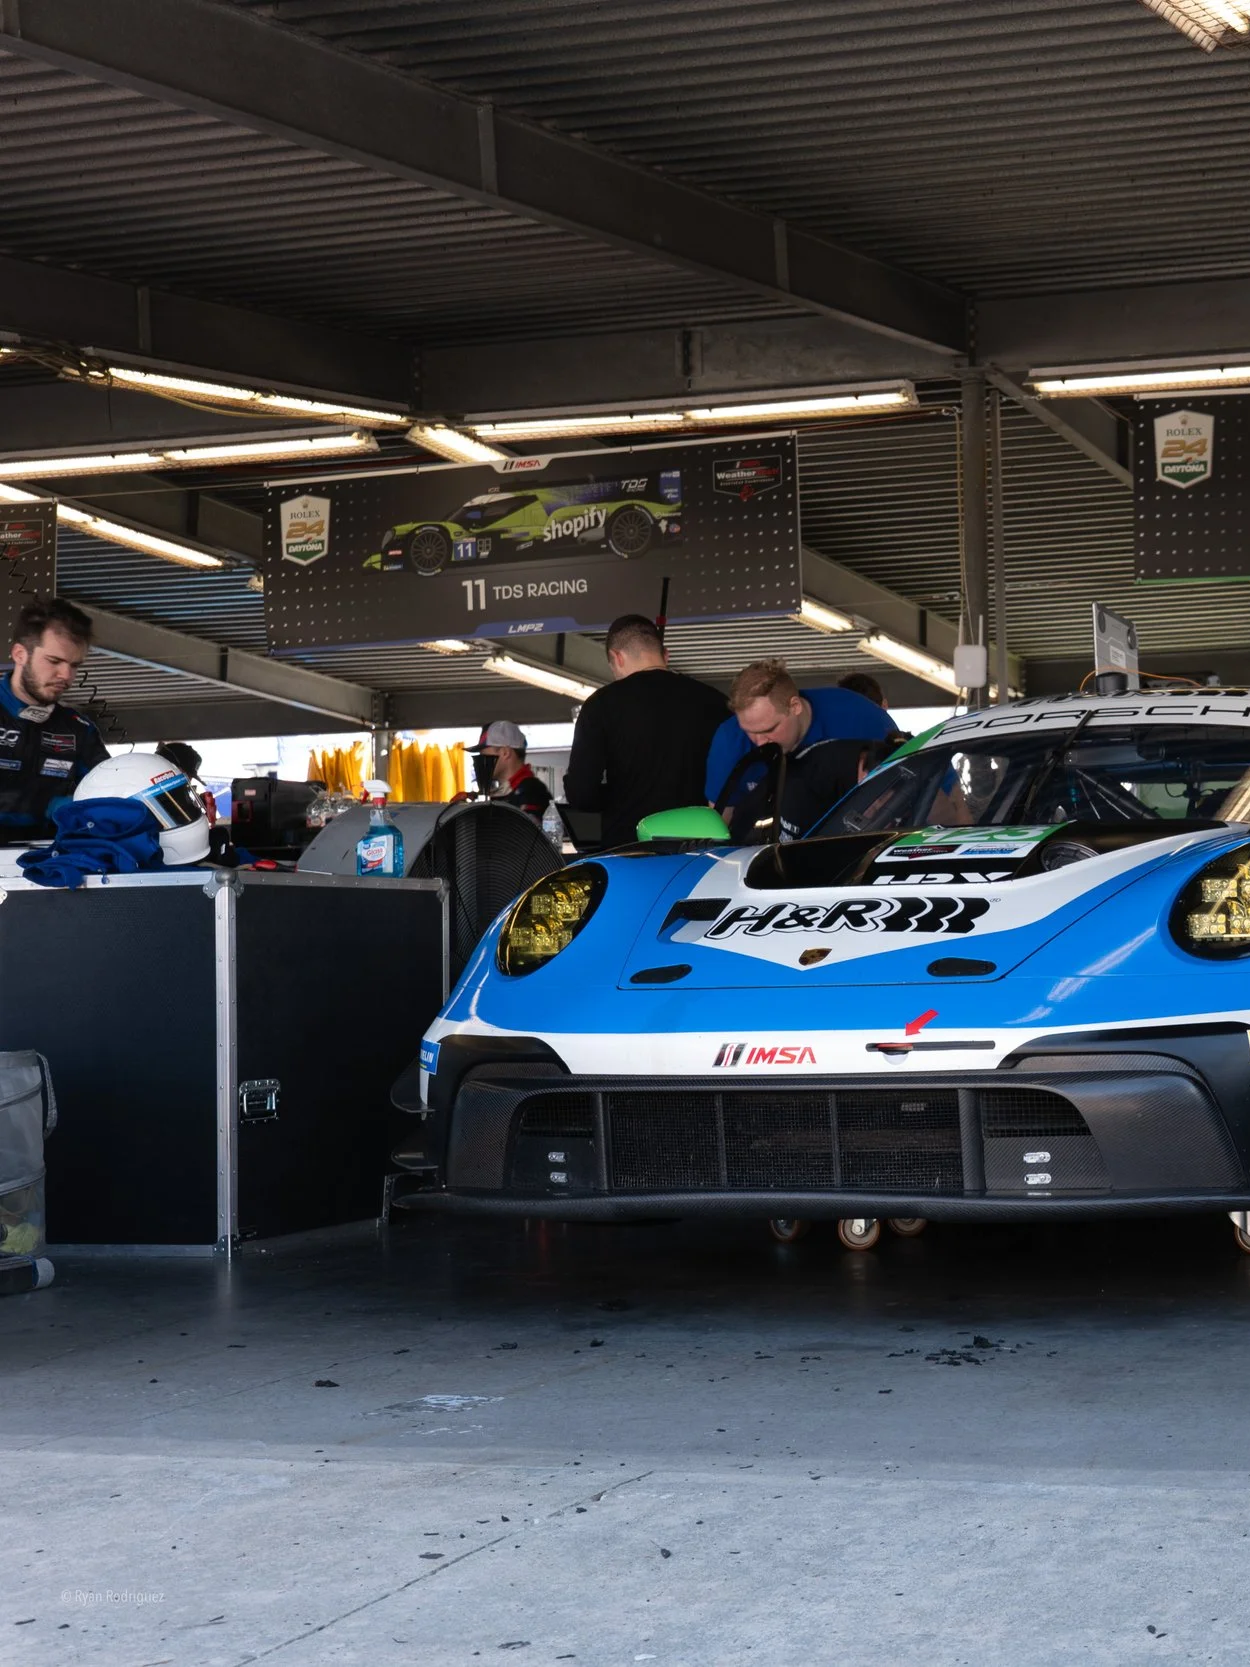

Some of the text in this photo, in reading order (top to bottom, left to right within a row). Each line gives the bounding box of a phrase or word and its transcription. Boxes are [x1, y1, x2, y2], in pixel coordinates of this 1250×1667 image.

[1166, 427, 1202, 437] ROLEX
[1161, 438, 1208, 458] 24
[515, 460, 541, 469] IMSA
[1164, 464, 1206, 473] DAYTONA
[621, 478, 648, 490] TDS
[290, 510, 320, 519] ROLEX
[286, 520, 325, 539] 24
[542, 505, 607, 542] shopify
[288, 543, 323, 553] DAYTONA
[457, 542, 473, 558] 11
[462, 579, 588, 611] 11 TDS RACING
[508, 623, 544, 634] LMP2
[704, 898, 893, 939] H&R
[746, 1047, 816, 1064] IMSA
